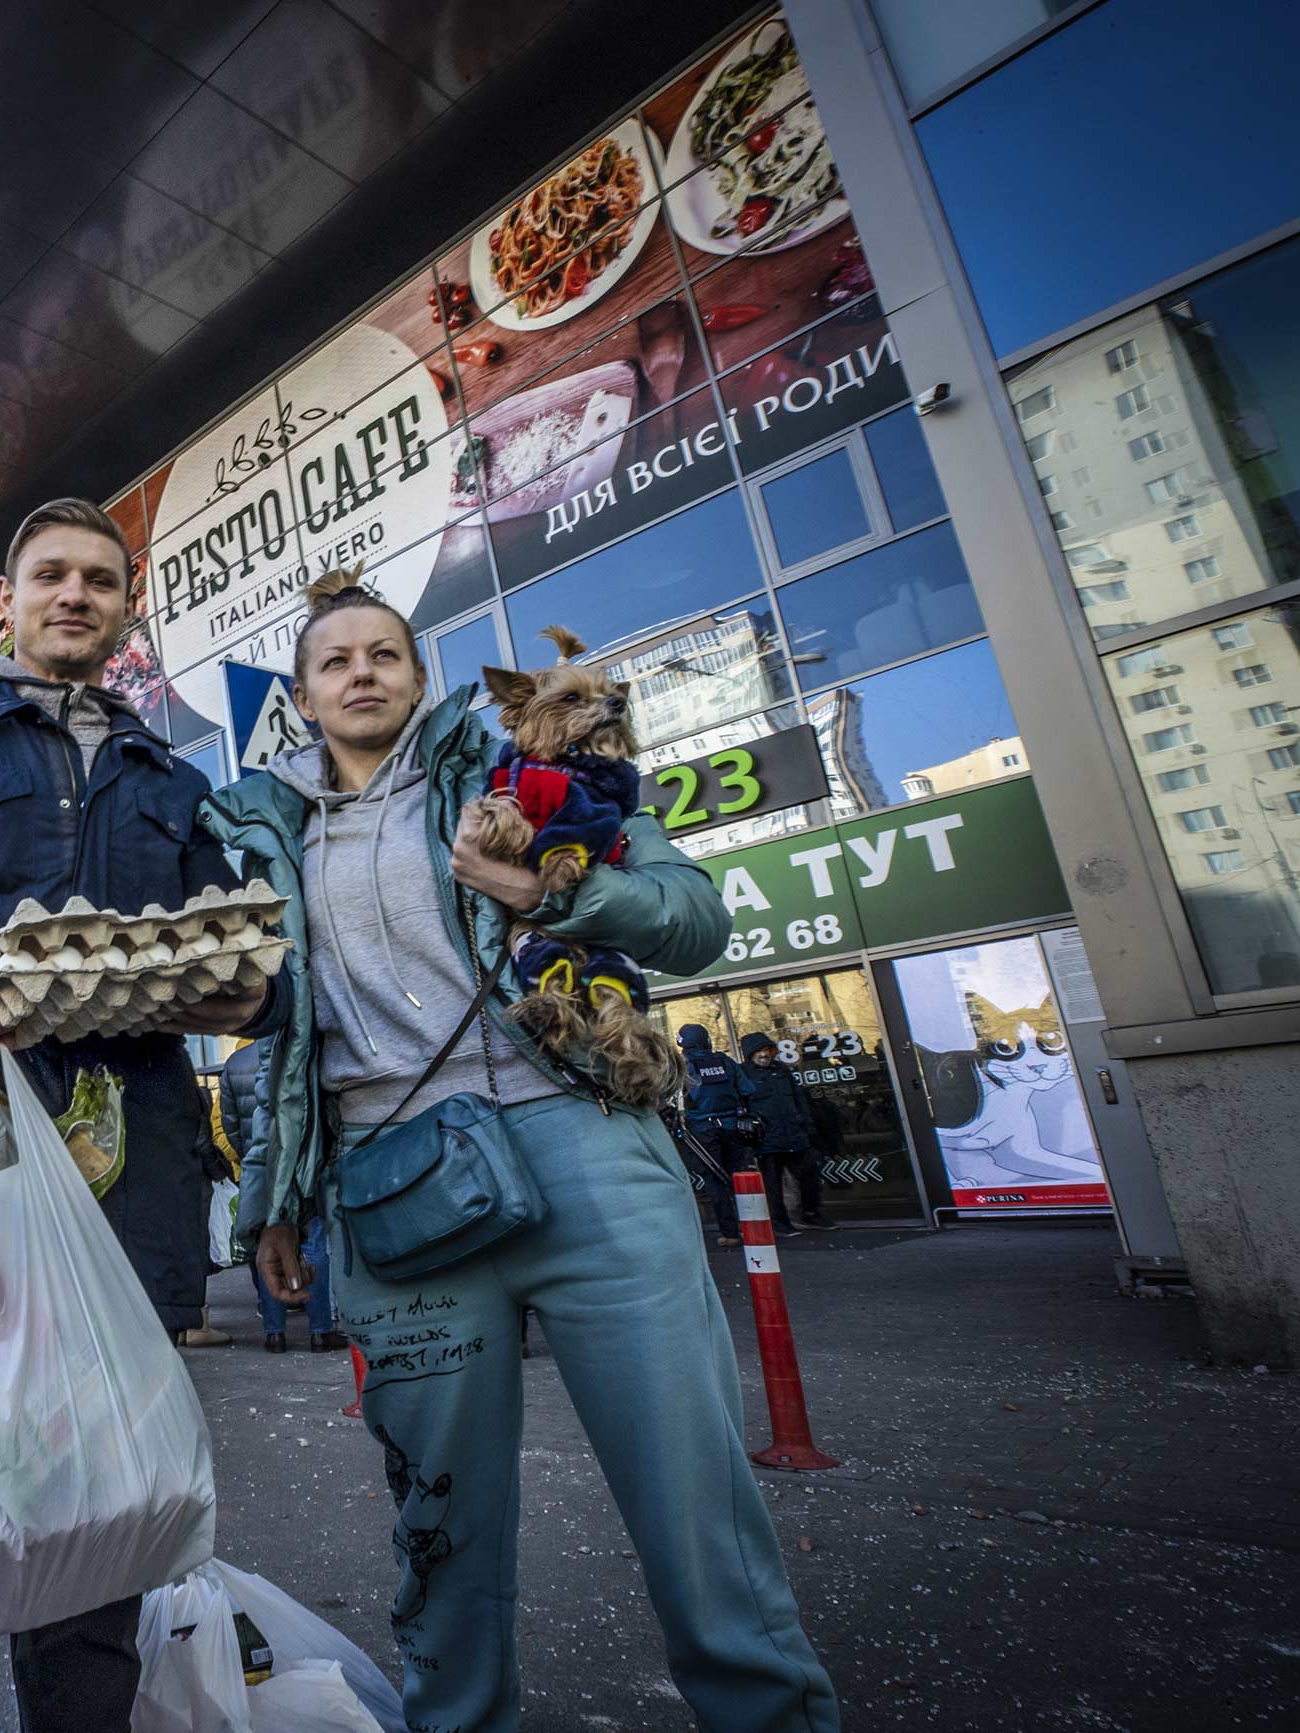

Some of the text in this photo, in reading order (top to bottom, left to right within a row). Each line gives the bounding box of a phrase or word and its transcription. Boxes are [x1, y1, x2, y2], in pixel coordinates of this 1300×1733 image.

[159, 395, 430, 625] PESTO CAFE
[545, 477, 617, 543] ДЛЯ
[626, 407, 742, 494] ВСІЄЇ
[208, 521, 386, 638] ITALIANO VERO
[789, 813, 964, 898] ТУТ
[724, 914, 843, 962] 62 68
[700, 1066, 725, 1078] PRESS
[986, 1193, 1025, 1203] PURINA
